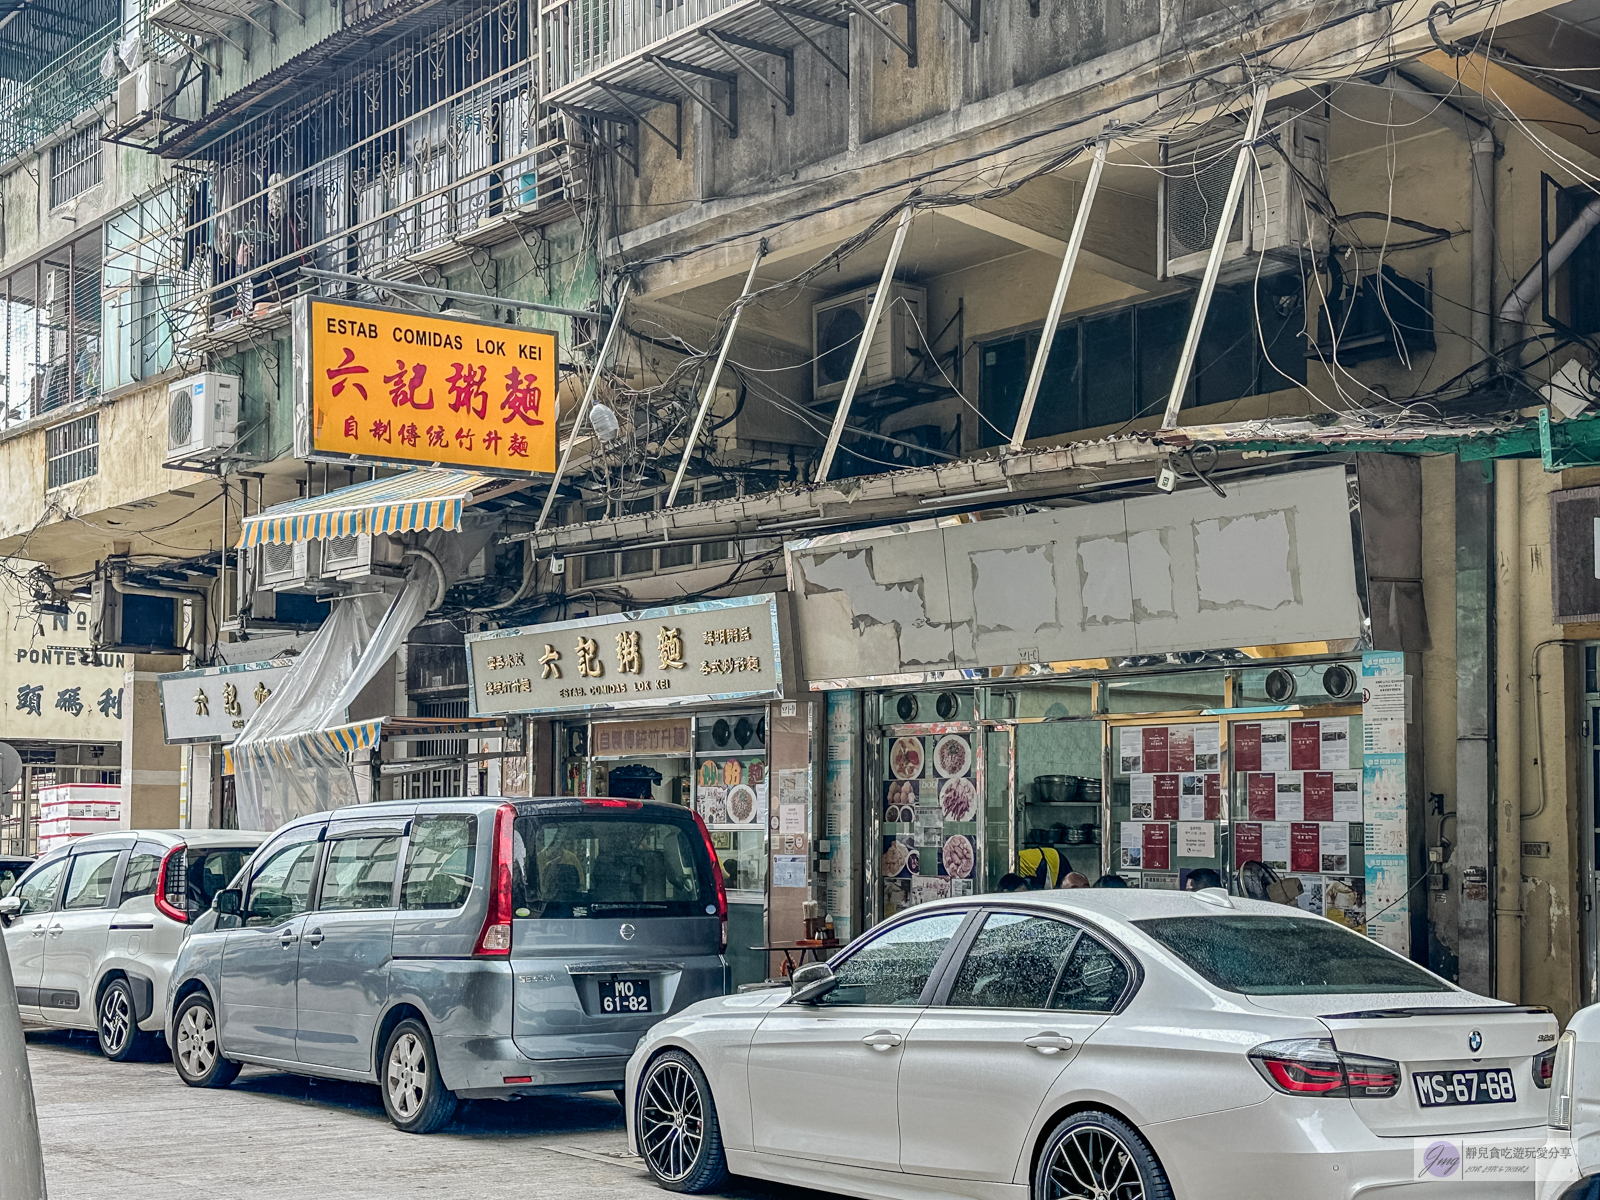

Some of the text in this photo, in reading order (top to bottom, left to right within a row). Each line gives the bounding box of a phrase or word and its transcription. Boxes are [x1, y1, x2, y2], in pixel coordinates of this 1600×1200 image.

[326, 317, 542, 361] ESTAB COMIDAS LOK KEI
[326, 347, 544, 426] 六記粥麵
[17, 648, 76, 666] PONTE
[537, 625, 687, 679] 六記粥麵
[589, 683, 628, 696] COMIDAS
[633, 680, 651, 692] LOK
[654, 679, 671, 690] KEI
[614, 981, 634, 997] MO
[603, 996, 648, 1012] 61-82
[1415, 1071, 1514, 1105] MS-67-68
